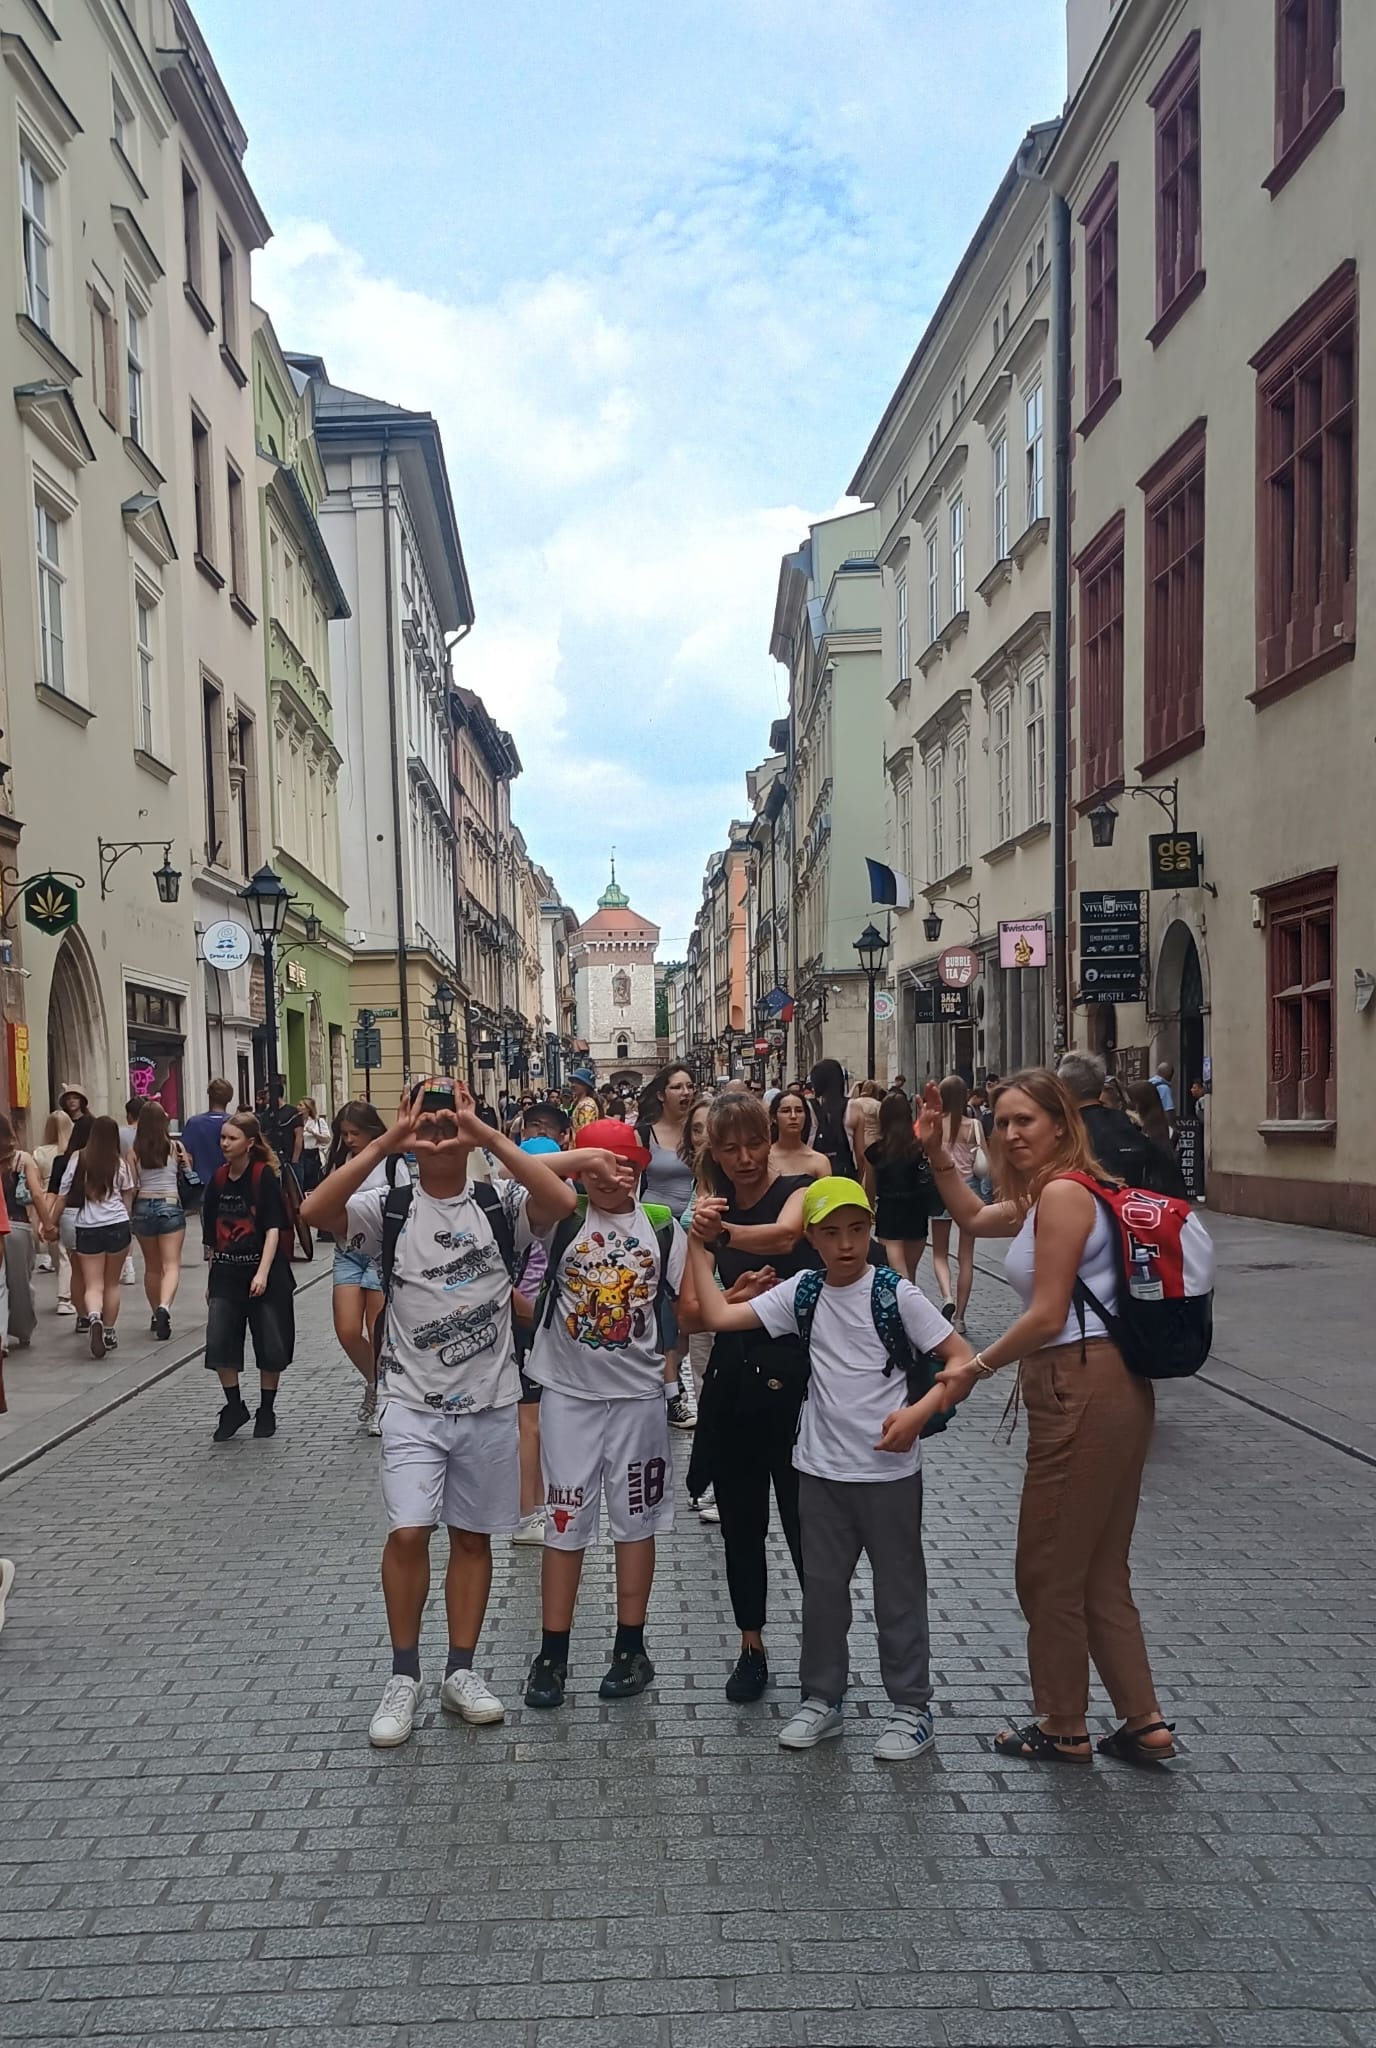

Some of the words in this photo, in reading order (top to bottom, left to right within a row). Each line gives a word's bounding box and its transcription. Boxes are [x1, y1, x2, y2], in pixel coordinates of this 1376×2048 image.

[1158, 840, 1192, 857] de
[1160, 856, 1191, 871] sa
[1082, 903, 1103, 912] VIVA
[1115, 903, 1138, 911] PINTA
[1002, 923, 1043, 933] Twistcafe
[945, 956, 971, 967] BUBBLE
[945, 968, 959, 979] TEA
[940, 993, 961, 1003] BAZA
[1097, 992, 1124, 1002] HOSTEL
[941, 1003, 956, 1014] PUB
[643, 1456, 666, 1508] 8
[627, 1461, 644, 1516] LAVINE
[546, 1483, 584, 1508] BULLS
